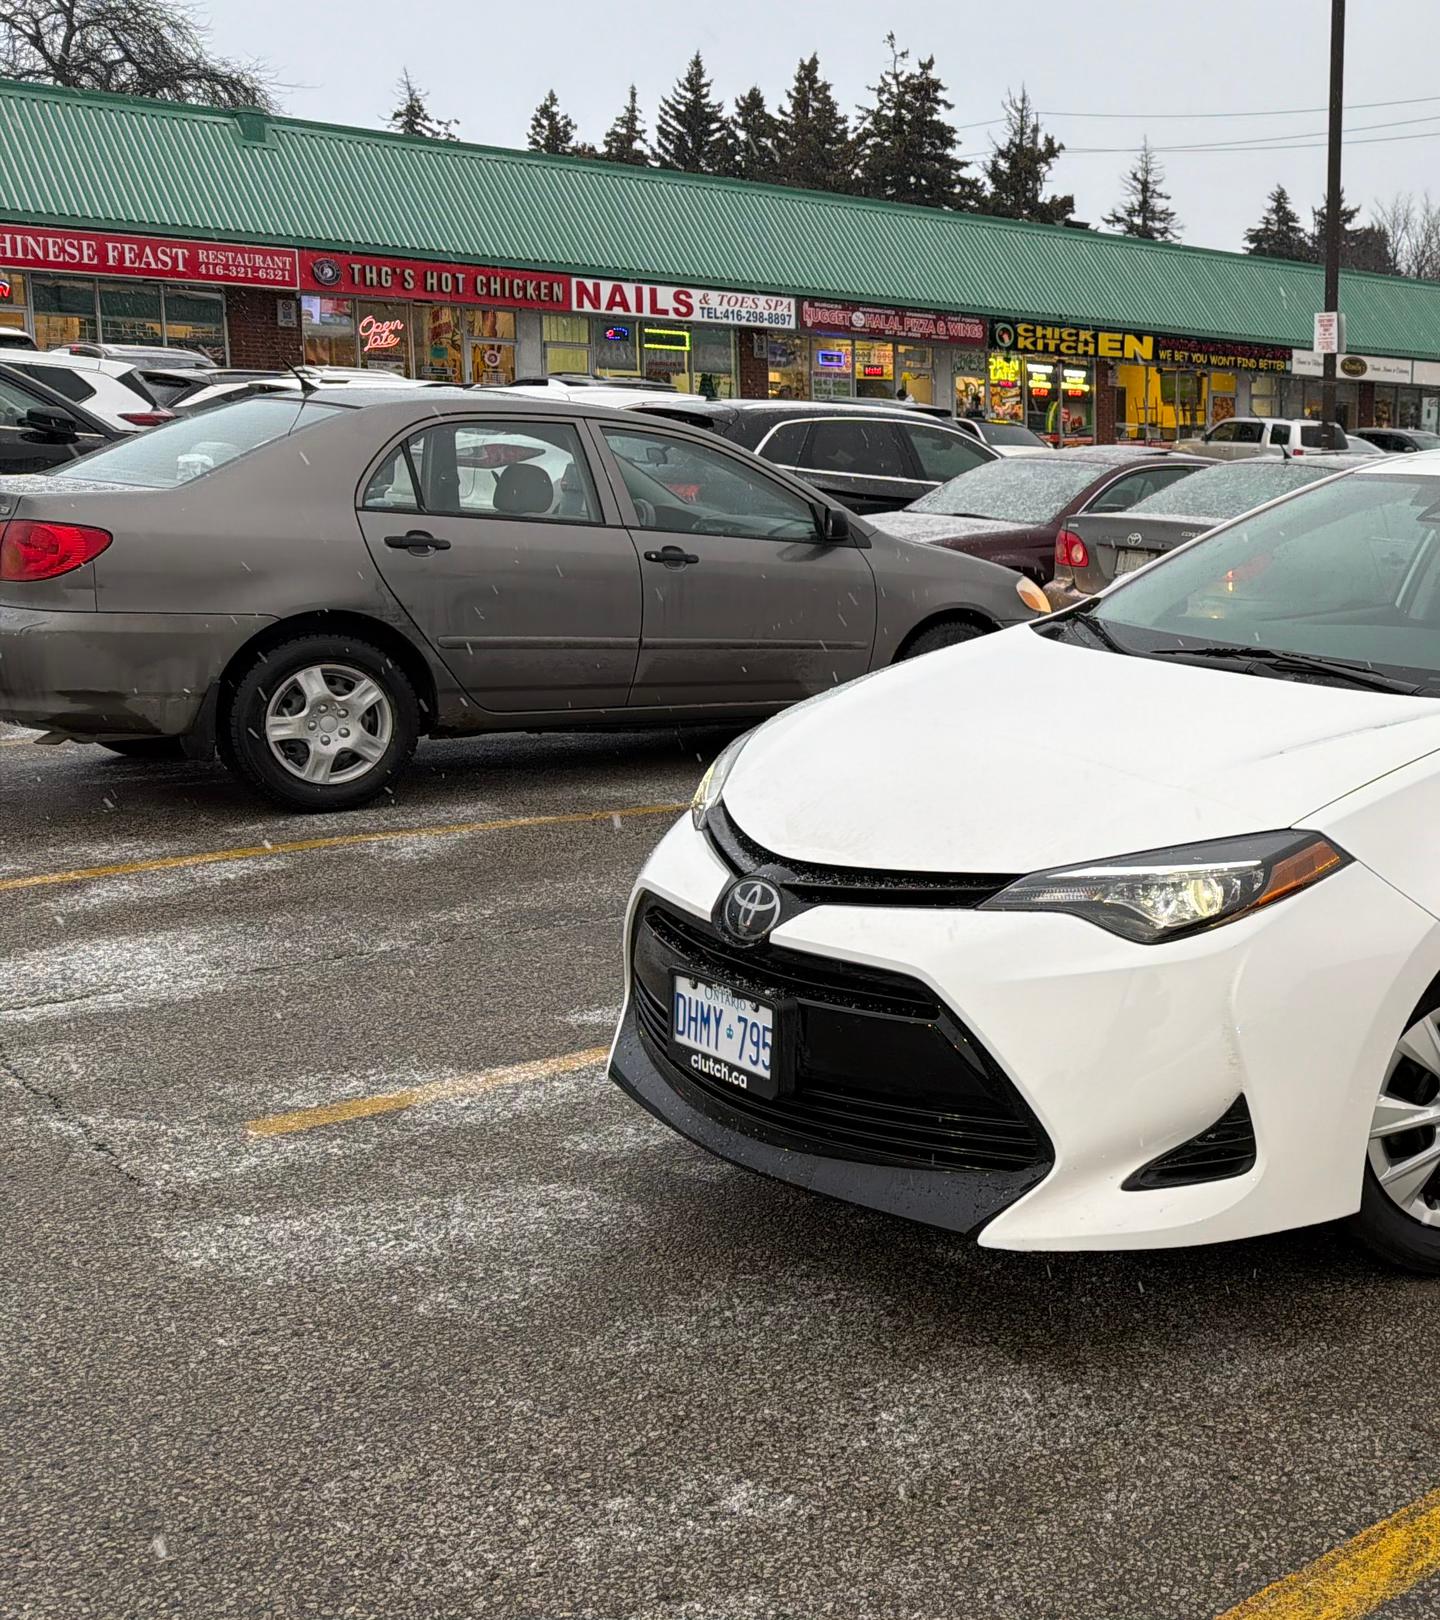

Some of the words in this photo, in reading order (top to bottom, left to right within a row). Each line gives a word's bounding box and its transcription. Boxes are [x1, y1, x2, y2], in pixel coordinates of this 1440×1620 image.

[105, 242, 189, 271] FEAST
[198, 250, 291, 269] RESTAURANT
[199, 264, 290, 280] 416-321-6321
[350, 263, 415, 289] THG'S
[426, 271, 466, 293] HOT
[476, 275, 564, 301] CHICKEN
[576, 281, 695, 318] NAILS
[699, 292, 711, 305] &
[717, 293, 760, 309] TOES
[763, 298, 792, 312] SPA
[360, 315, 404, 335] Open
[700, 306, 792, 326] TEL:416-298-8897
[864, 314, 902, 330] HALAL
[904, 317, 936, 334] PIZZA
[948, 322, 983, 338] WINGS
[1017, 323, 1096, 342] CHICK
[1098, 332, 1154, 360] EN
[1017, 337, 1096, 355] KITCH
[989, 357, 1019, 371] OPEN
[1159, 349, 1173, 360] WE
[1175, 351, 1189, 361] BET
[1191, 353, 1208, 363] YOU
[1237, 357, 1257, 368] FIND
[1259, 359, 1287, 370] BETTER
[704, 987, 746, 1011] ONTARIO
[675, 992, 723, 1051] DHMY
[737, 1015, 773, 1071] 795
[690, 1054, 747, 1089] clutch.ca
